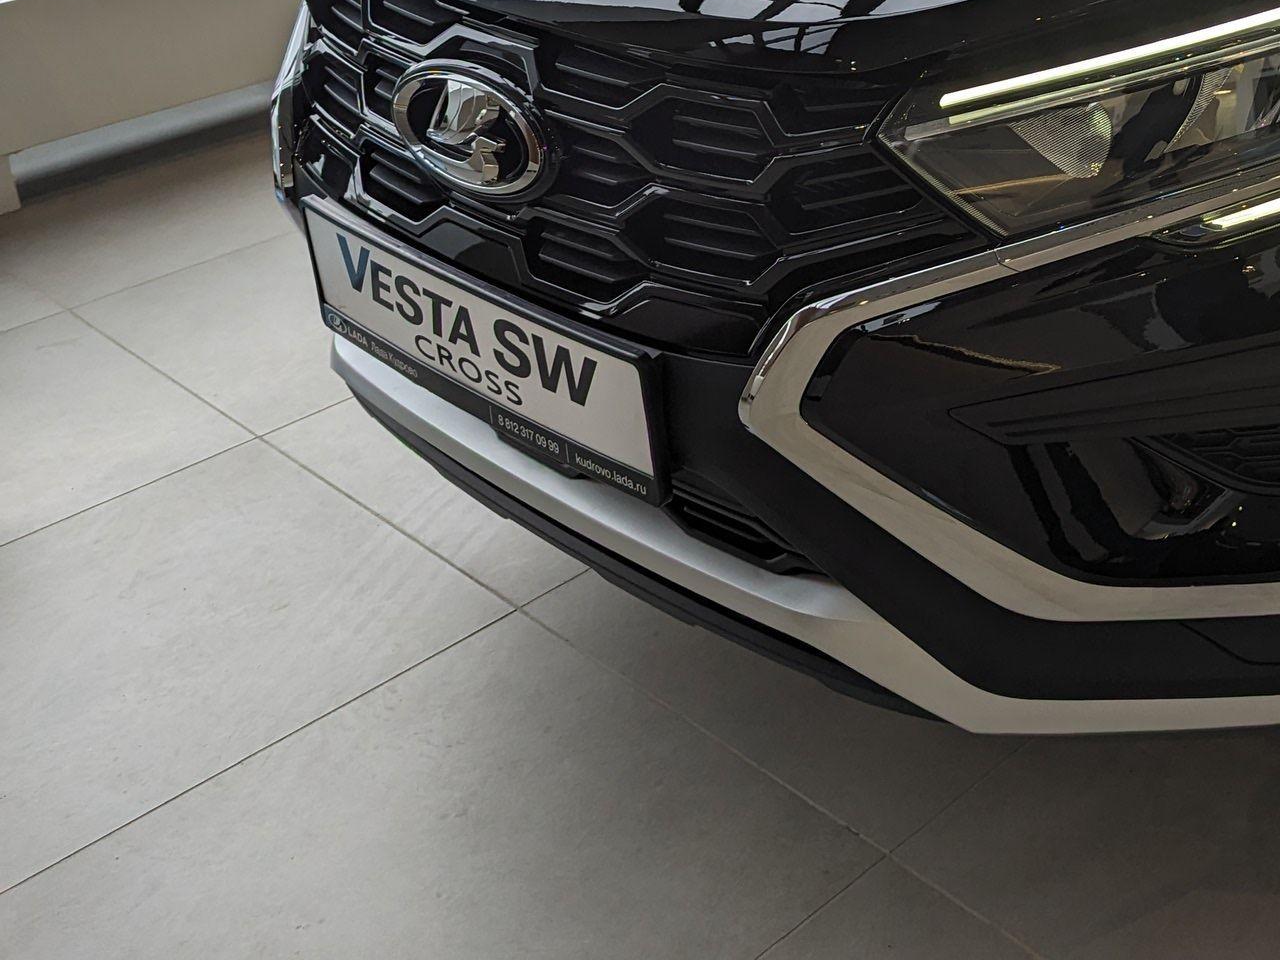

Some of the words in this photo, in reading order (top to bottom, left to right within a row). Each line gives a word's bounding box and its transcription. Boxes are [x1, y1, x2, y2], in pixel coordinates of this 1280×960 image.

[336, 233, 481, 358] VESTA
[493, 318, 598, 407] SW
[347, 326, 368, 347] LADA
[414, 334, 523, 406] CROSS
[498, 415, 504, 426] 8
[505, 418, 519, 434] 812
[520, 425, 534, 441] 317
[535, 433, 547, 448] 09
[548, 439, 560, 454] 99
[575, 453, 647, 495] kudrovo.lada.ru
